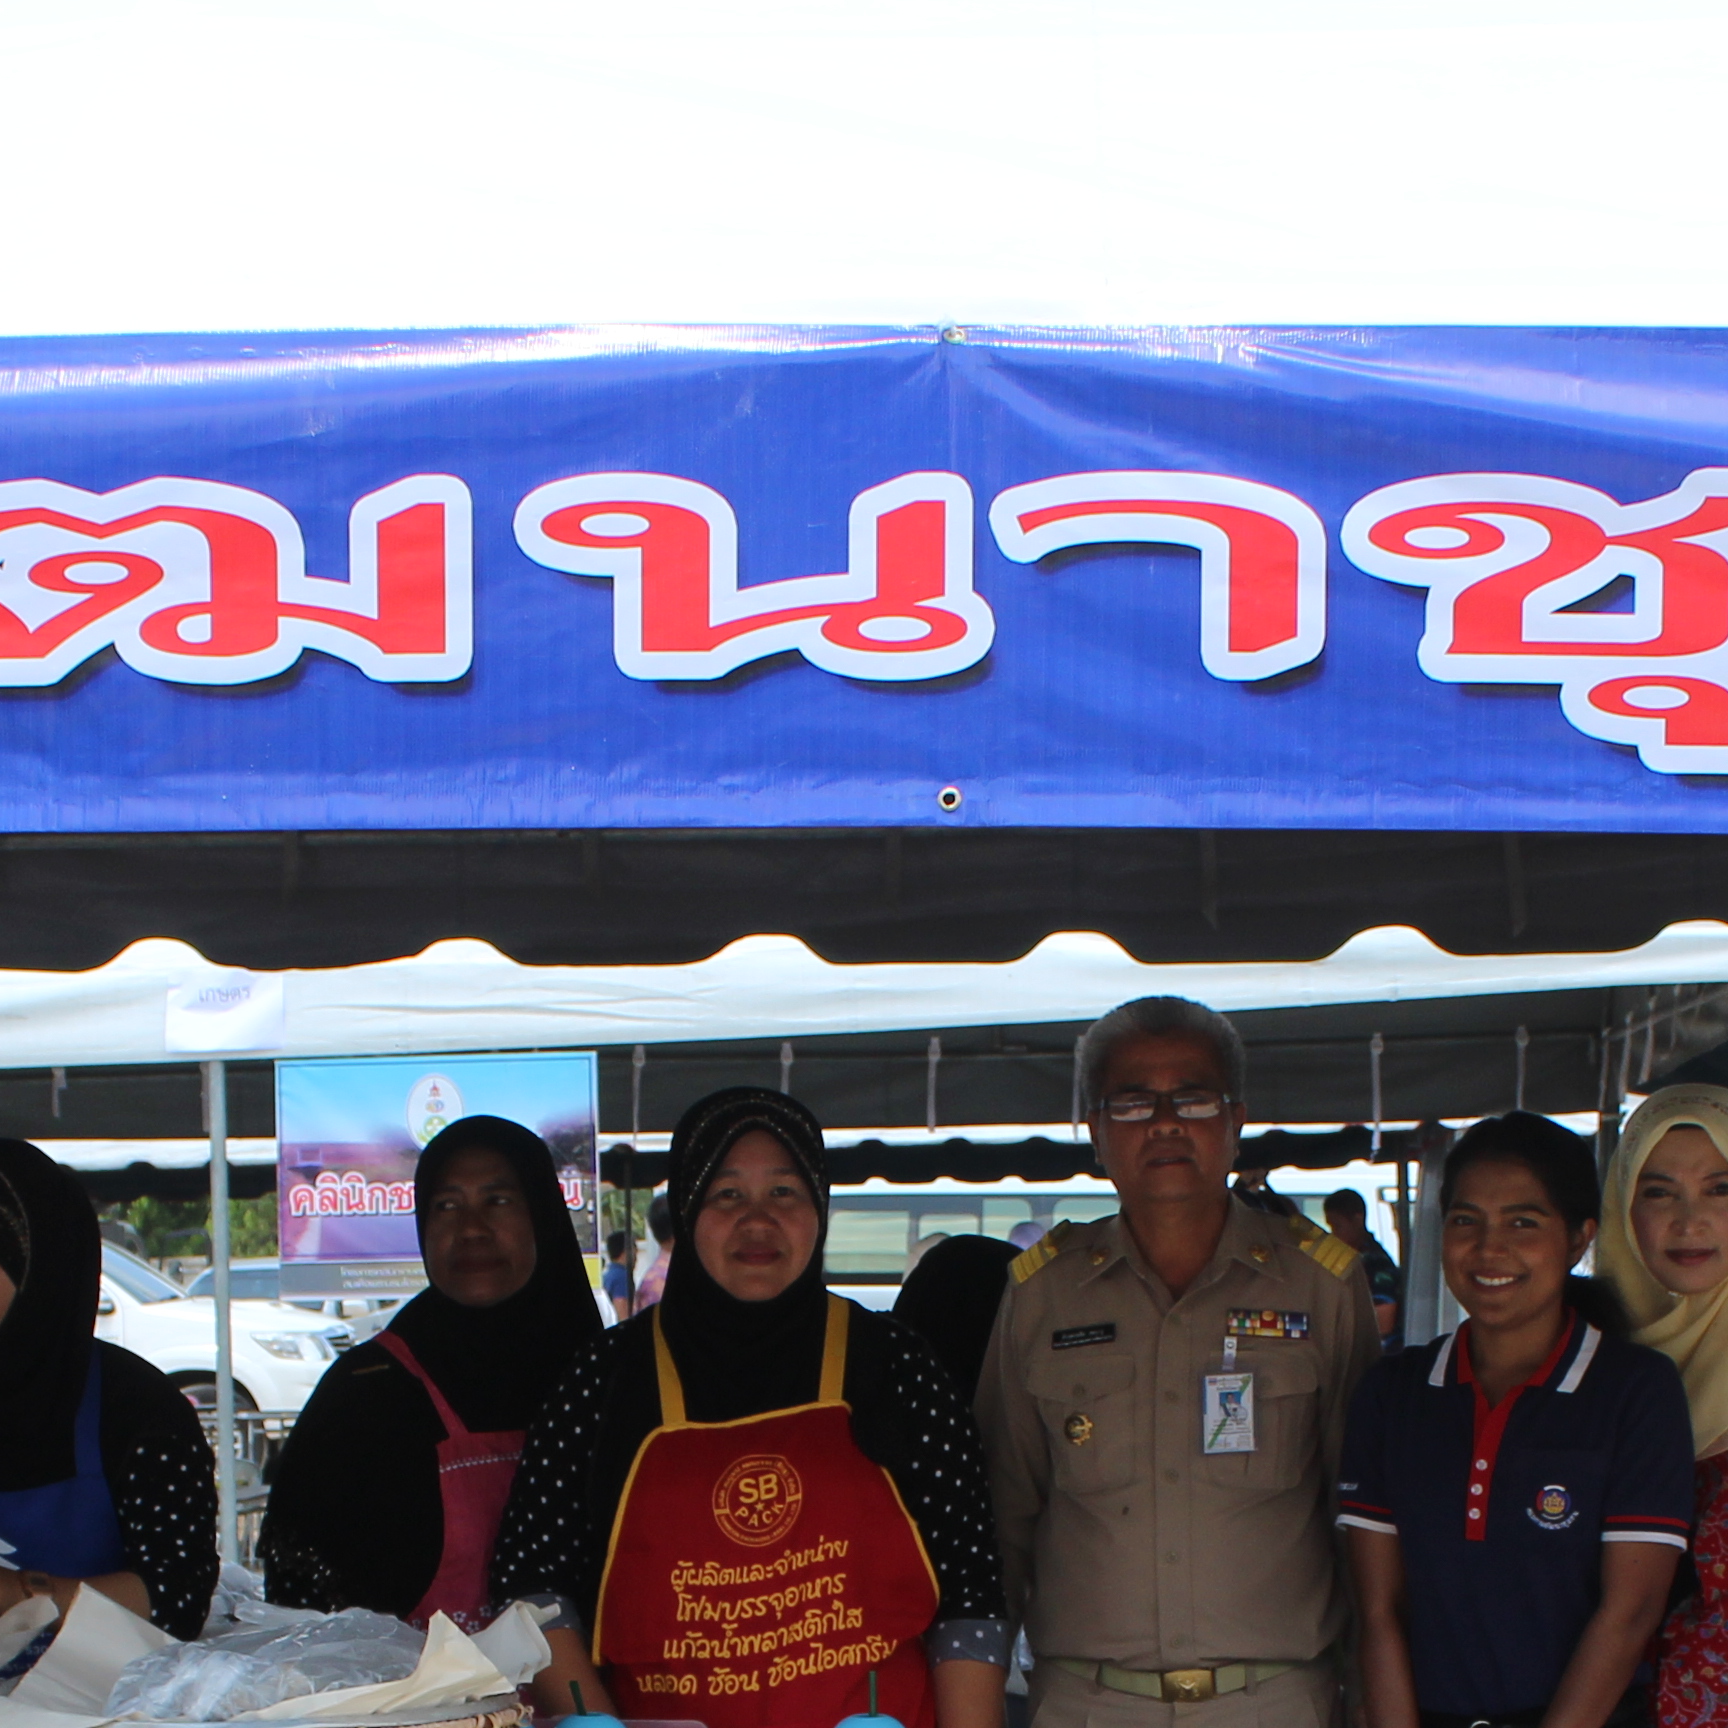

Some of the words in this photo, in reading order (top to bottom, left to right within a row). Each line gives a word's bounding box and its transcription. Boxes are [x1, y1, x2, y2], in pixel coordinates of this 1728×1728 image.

[735, 1501, 784, 1527] PACK
[738, 1473, 779, 1504] SB
[671, 1535, 849, 1592] ผู้ผลิตและจำหน่าย
[676, 1573, 847, 1622] โฟมบรรจุอาหาร
[663, 1600, 864, 1660] แก้วน้ำพลาสติกใส
[636, 1673, 698, 1696] หลอด
[708, 1667, 760, 1696] ช้อน
[768, 1635, 898, 1689] ช้อนไอศกรีม
